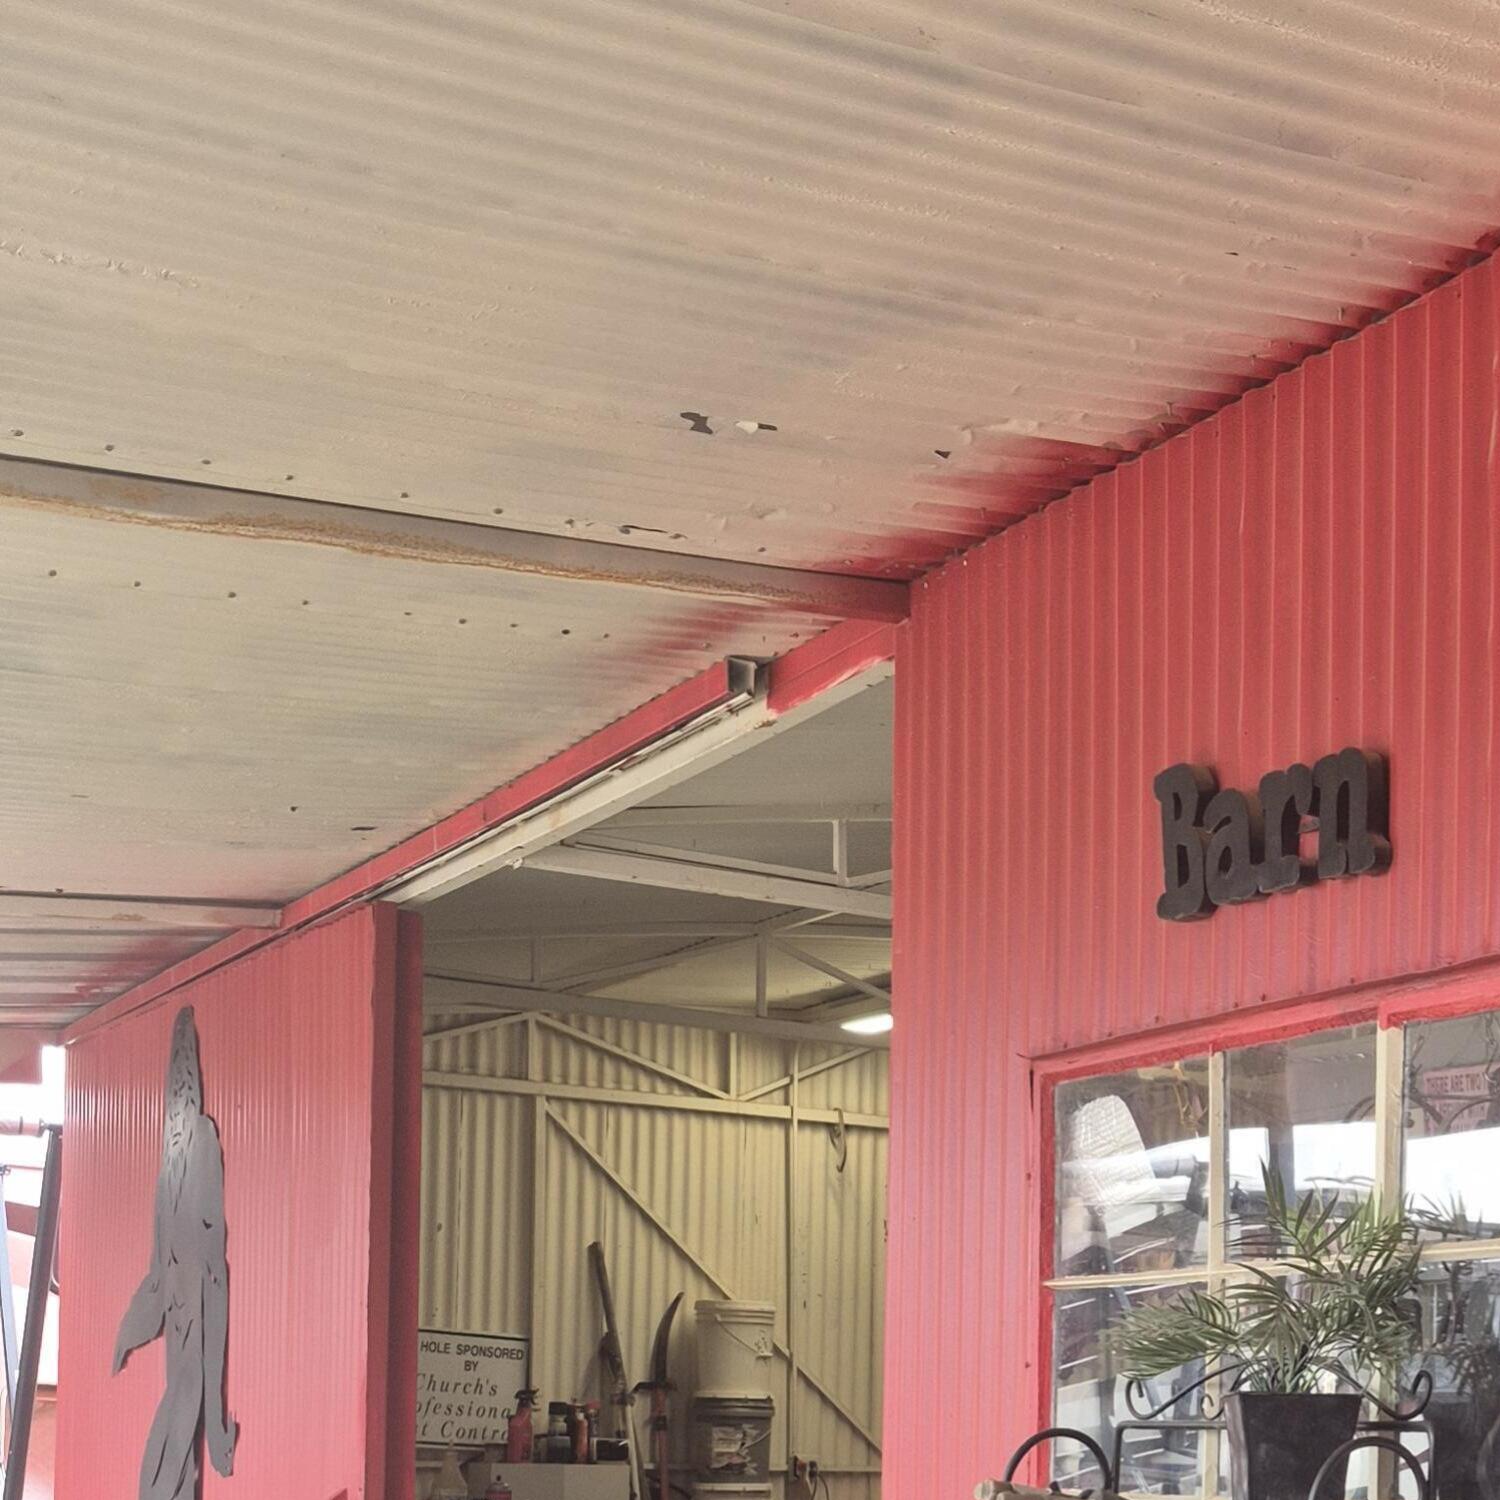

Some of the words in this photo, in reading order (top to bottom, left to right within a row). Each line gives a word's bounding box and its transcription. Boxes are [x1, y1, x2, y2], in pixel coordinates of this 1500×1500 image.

[1154, 747, 1380, 921] Barn
[420, 1341, 451, 1354] HOLE
[456, 1344, 525, 1360] SPONSORED
[464, 1360, 479, 1372] BY
